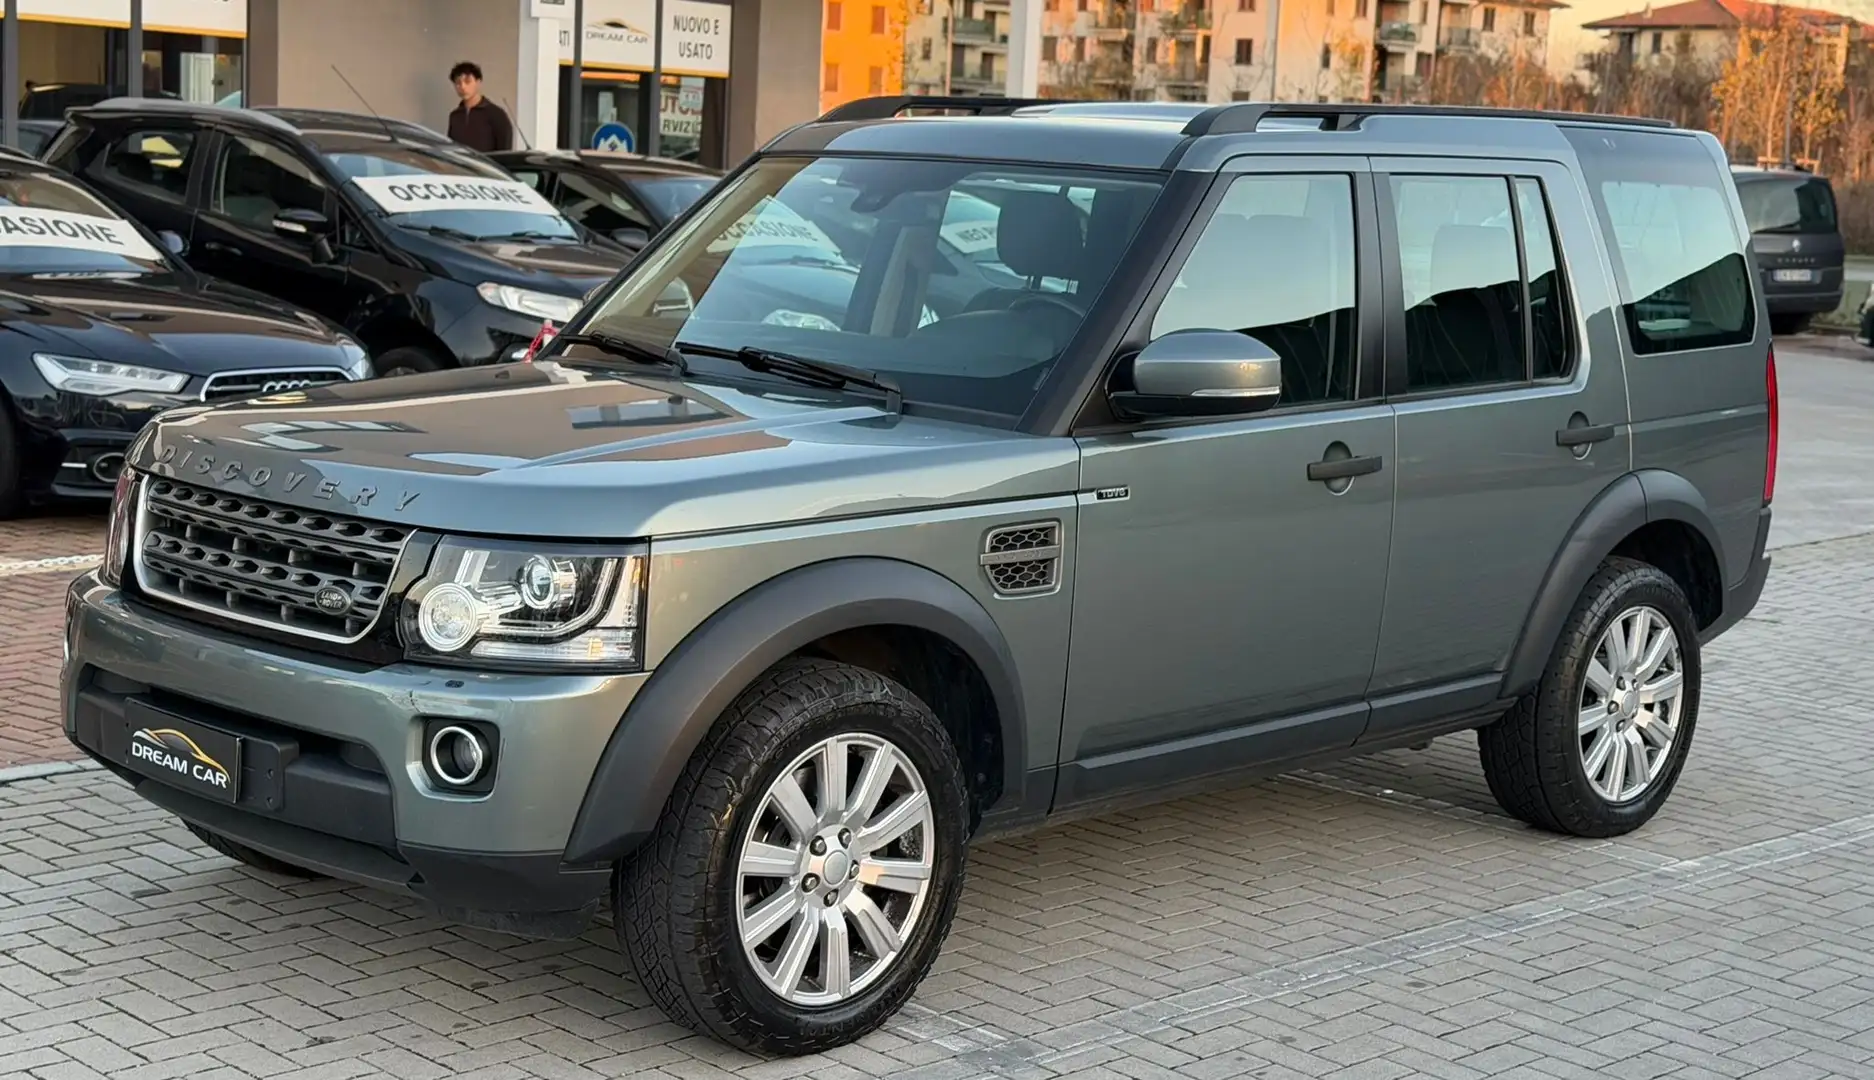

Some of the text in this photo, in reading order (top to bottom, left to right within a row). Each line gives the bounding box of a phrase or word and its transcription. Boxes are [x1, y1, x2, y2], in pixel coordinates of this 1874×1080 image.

[673, 15, 720, 36] NUOVO E
[586, 31, 648, 44] DREAM CAR
[679, 41, 713, 60] USATO
[388, 183, 532, 205] OCCASIONE
[0, 216, 124, 246] ASIONE
[158, 444, 421, 512] DISCOVERY
[132, 741, 227, 789] DREAM CAR
